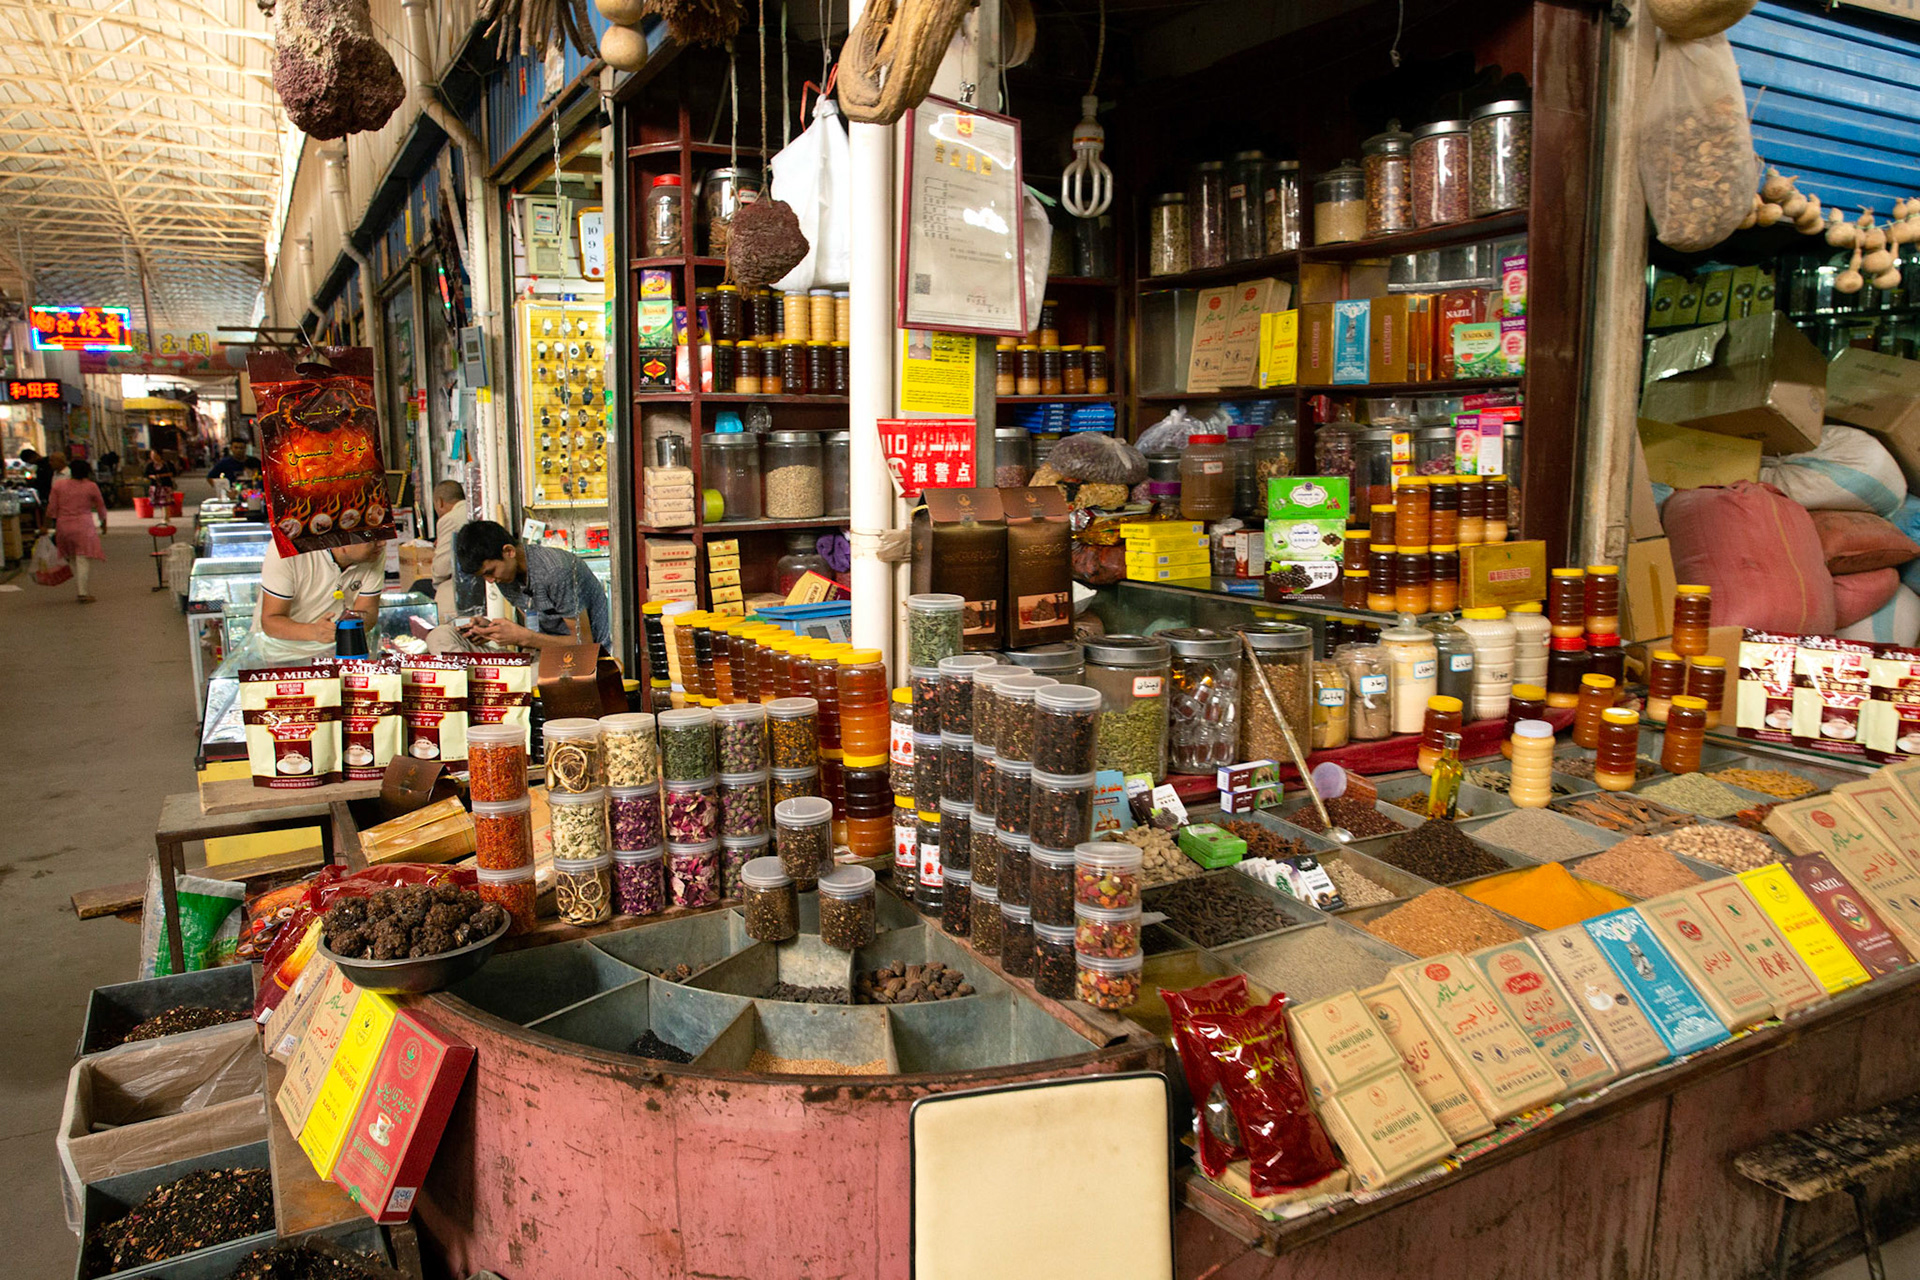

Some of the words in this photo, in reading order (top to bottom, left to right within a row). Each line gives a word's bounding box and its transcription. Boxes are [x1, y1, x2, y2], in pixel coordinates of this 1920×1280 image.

[588, 227, 598, 235] 10
[588, 241, 597, 249] 9
[1446, 309, 1472, 319] NAZIL
[912, 462, 971, 483] 报警点
[418, 661, 460, 669] MIRAS
[479, 657, 524, 666] MIRAS
[249, 671, 278, 681] ATA
[282, 669, 331, 680] MIRAS
[1809, 877, 1845, 894] NAZIL
[1429, 1073, 1445, 1083] TEA
[321, 1097, 332, 1113] BLACK
[377, 1099, 392, 1115] BLACK
[392, 1112, 402, 1125] TEA
